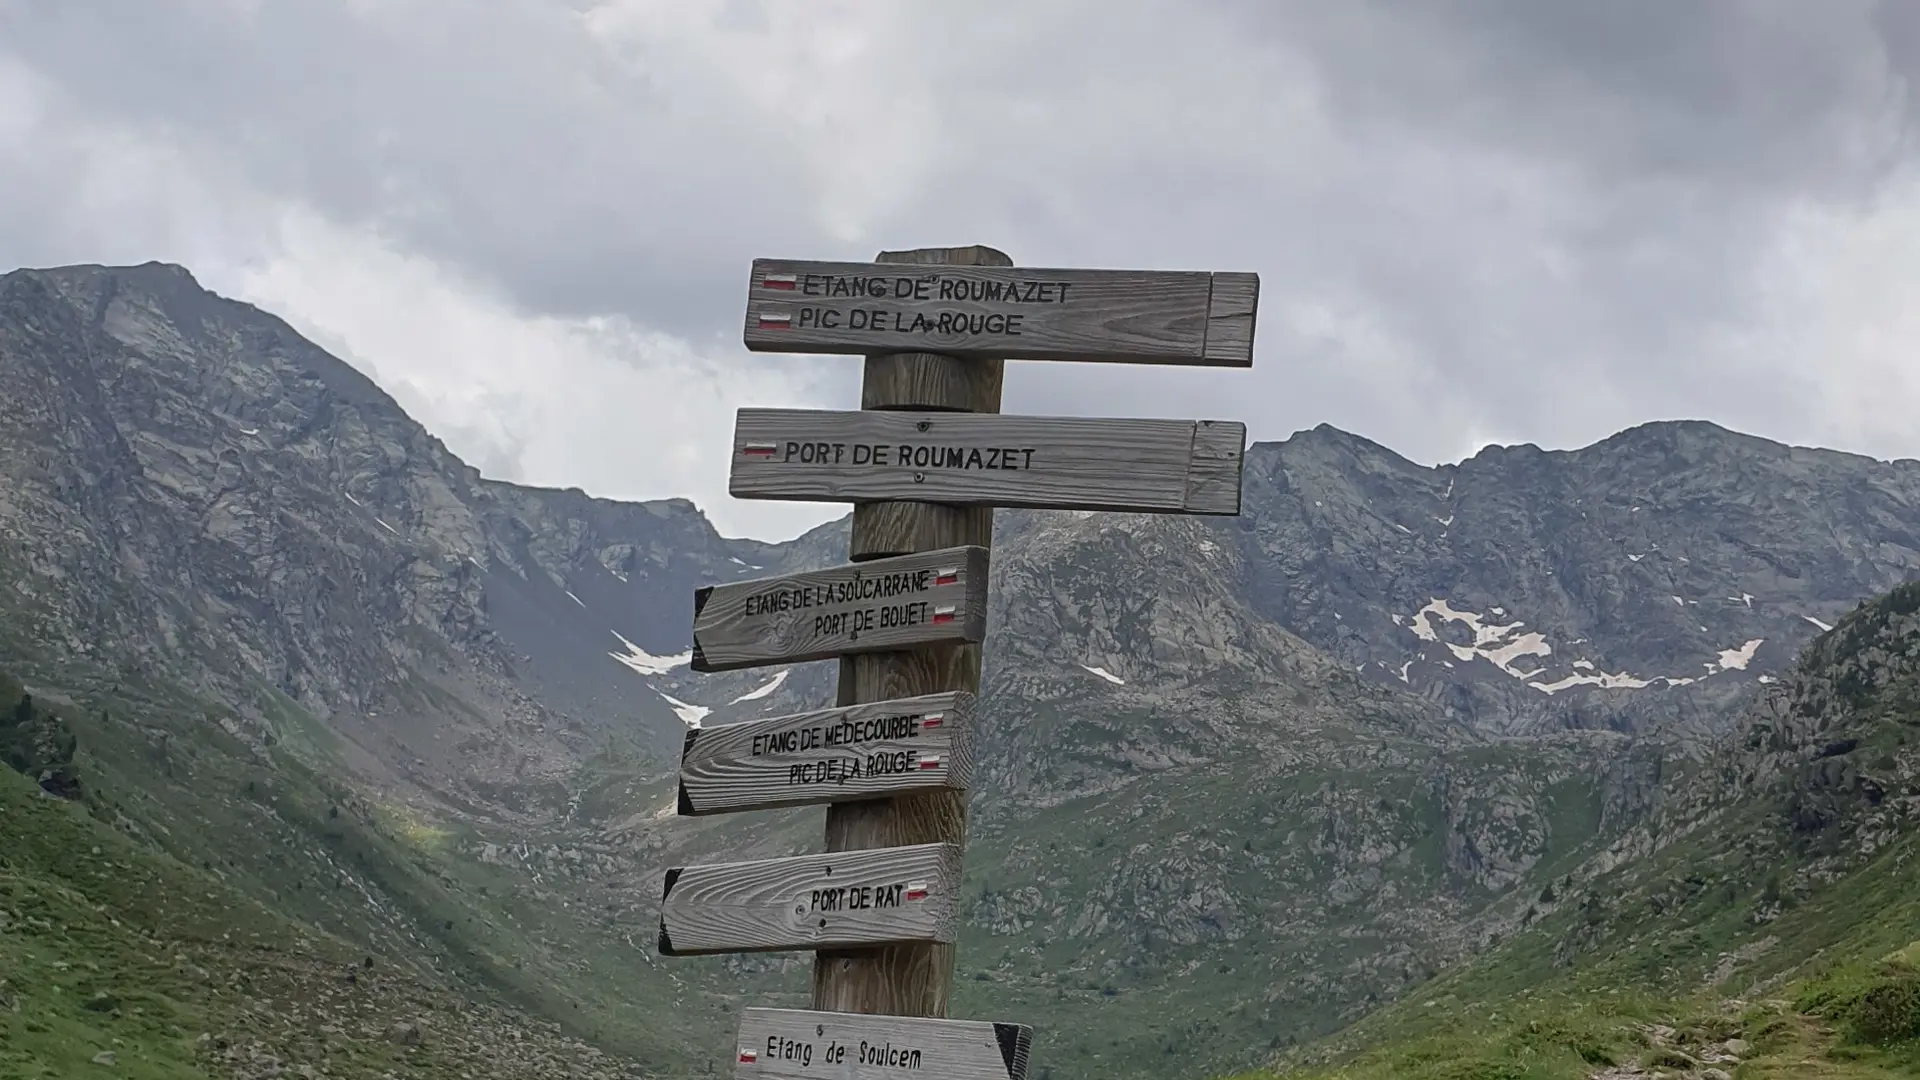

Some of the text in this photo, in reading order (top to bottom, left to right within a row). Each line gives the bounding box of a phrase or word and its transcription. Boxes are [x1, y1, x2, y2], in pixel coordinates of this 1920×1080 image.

[803, 274, 1072, 303] ETANG DE ROUMAZET
[800, 308, 1024, 335] PIC DE LA ROUGE
[785, 442, 1035, 470] PORT DE ROUMAZET
[745, 570, 930, 616] ETANG DE LA SOUCARRANE
[814, 602, 928, 638] PORT DE BOUET
[752, 715, 920, 756] ETANG DE MEDECOURBE
[790, 751, 917, 785] PIC DE LA ROUGE
[811, 885, 903, 911] PORT DE RAT
[766, 1036, 921, 1069] Etang de Soulcem
